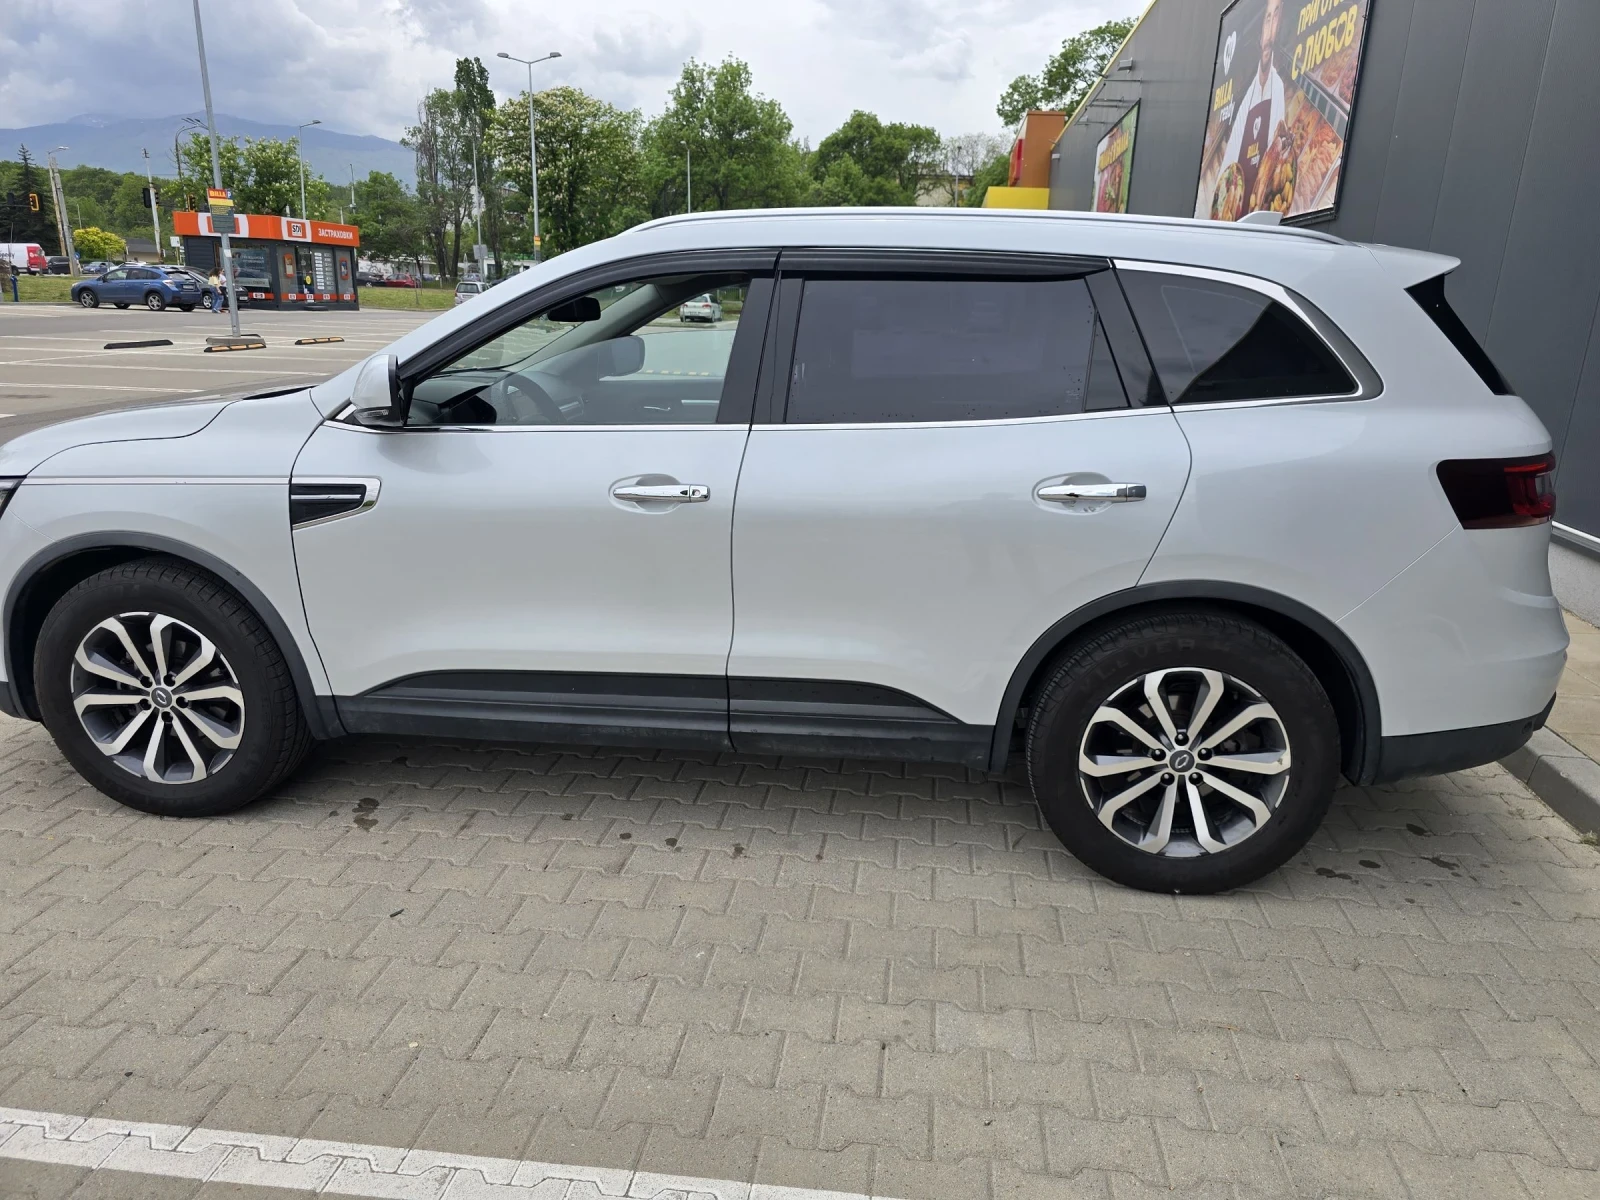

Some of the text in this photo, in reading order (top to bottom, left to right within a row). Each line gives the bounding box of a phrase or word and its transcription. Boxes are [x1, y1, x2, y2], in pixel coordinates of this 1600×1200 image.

[1291, 4, 1357, 81] С ЛЮБОВ
[318, 228, 353, 240] ЗАСТРАХОВКИ
